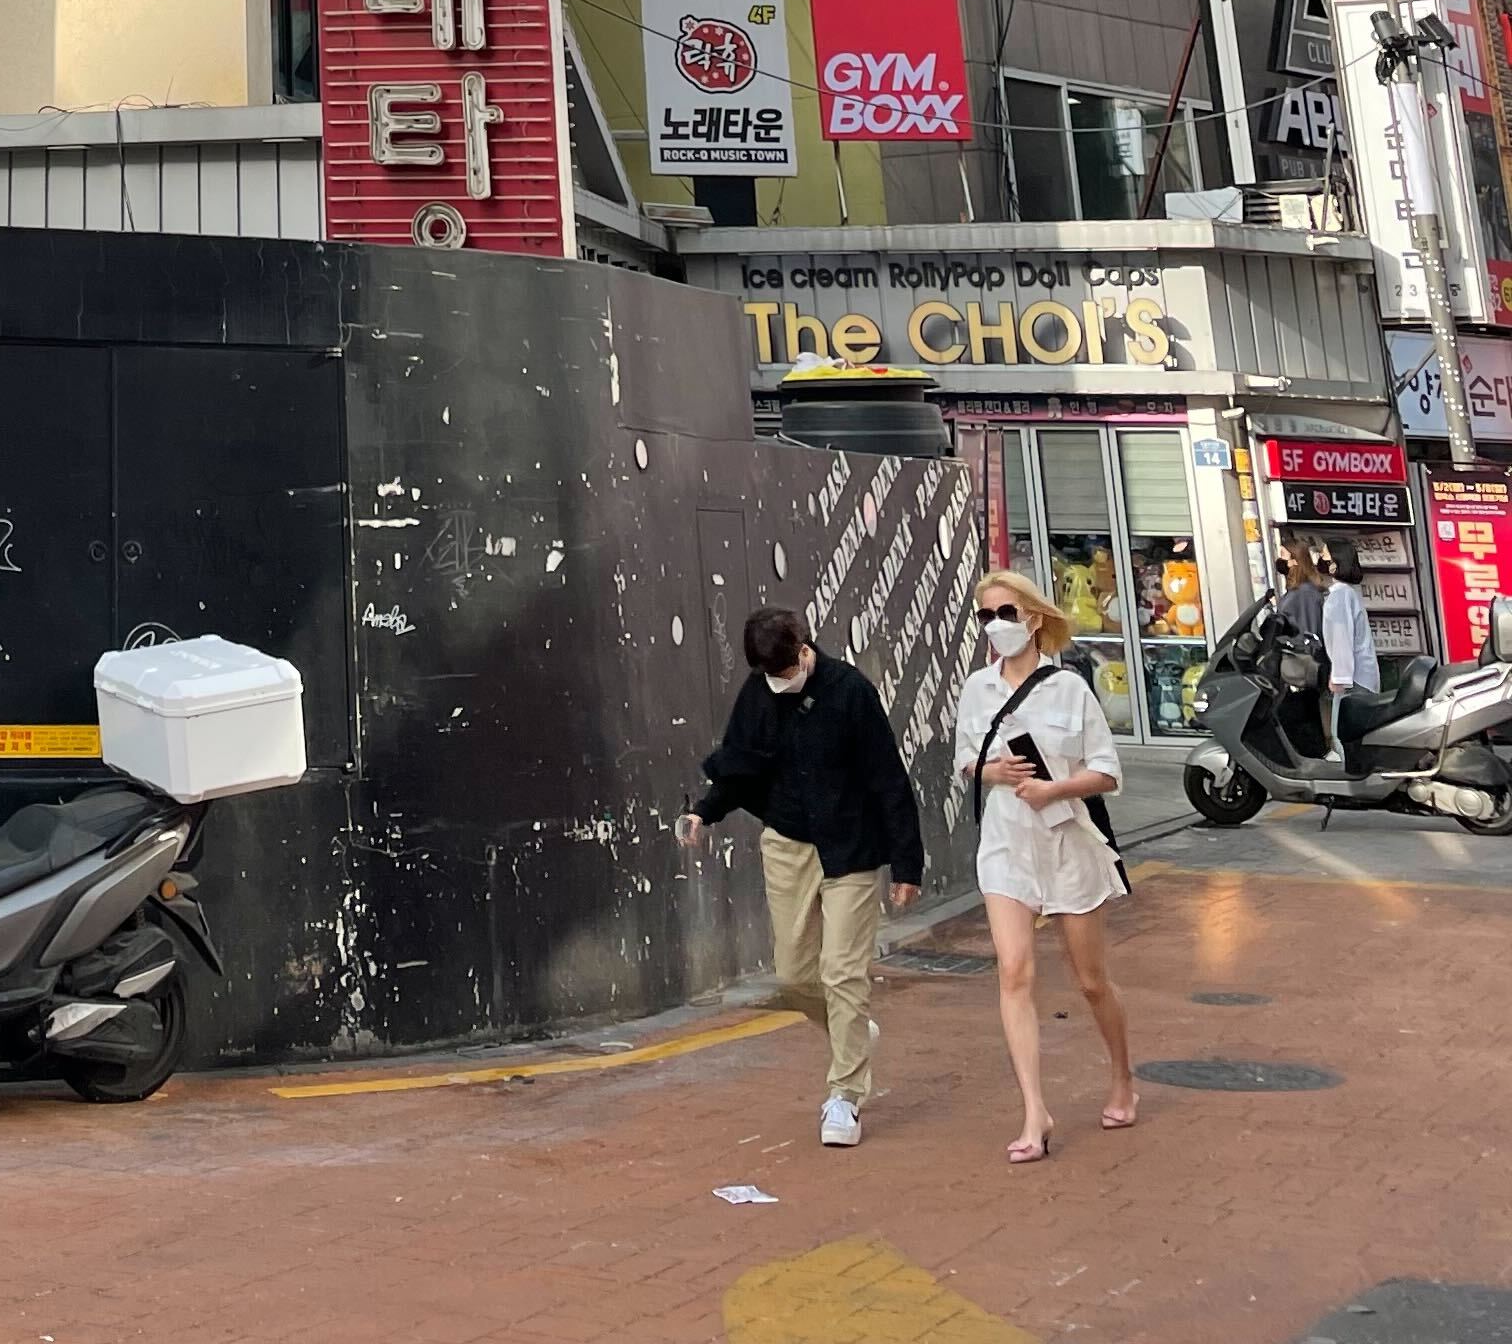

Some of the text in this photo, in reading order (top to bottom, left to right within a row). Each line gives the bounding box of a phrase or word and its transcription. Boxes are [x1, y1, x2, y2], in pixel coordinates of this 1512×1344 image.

[747, 5, 777, 25] 4F
[823, 52, 937, 92] GYM
[659, 107, 784, 144] 노래타운
[829, 93, 964, 134] BOXX
[663, 149, 785, 162] ROCK-Q MUSIC TOWN
[741, 260, 1159, 292] Ice cream RollyPop Doll Caps
[744, 297, 1170, 366] The CHOI'S
[1202, 451, 1221, 466] 14
[1282, 448, 1393, 474] 5F GYMBOXX
[1287, 492, 1306, 512] 4F
[1331, 491, 1399, 517] 노래타운
[805, 505, 867, 643] PASADENA
